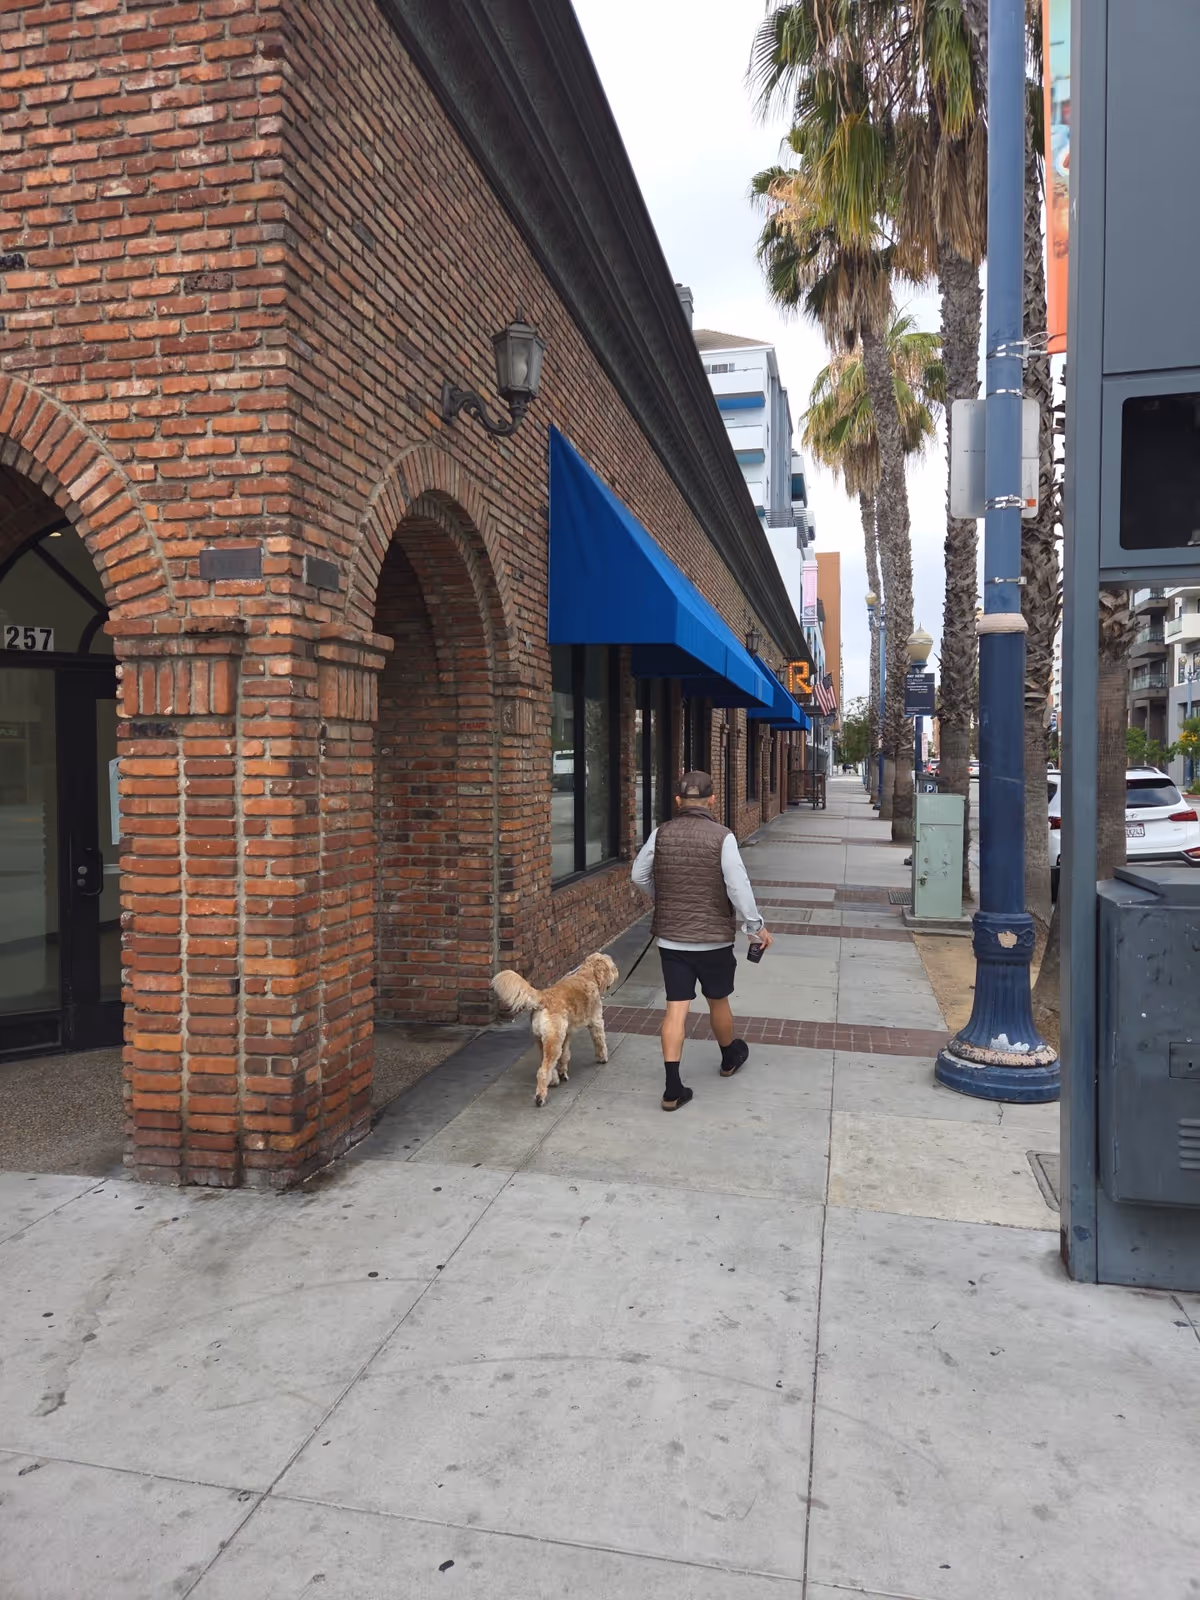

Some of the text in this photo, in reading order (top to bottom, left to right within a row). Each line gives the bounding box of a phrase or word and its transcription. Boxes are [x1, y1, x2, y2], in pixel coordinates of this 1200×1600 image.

[6, 626, 52, 651] 257
[788, 661, 813, 694] R
[926, 784, 933, 793] P
